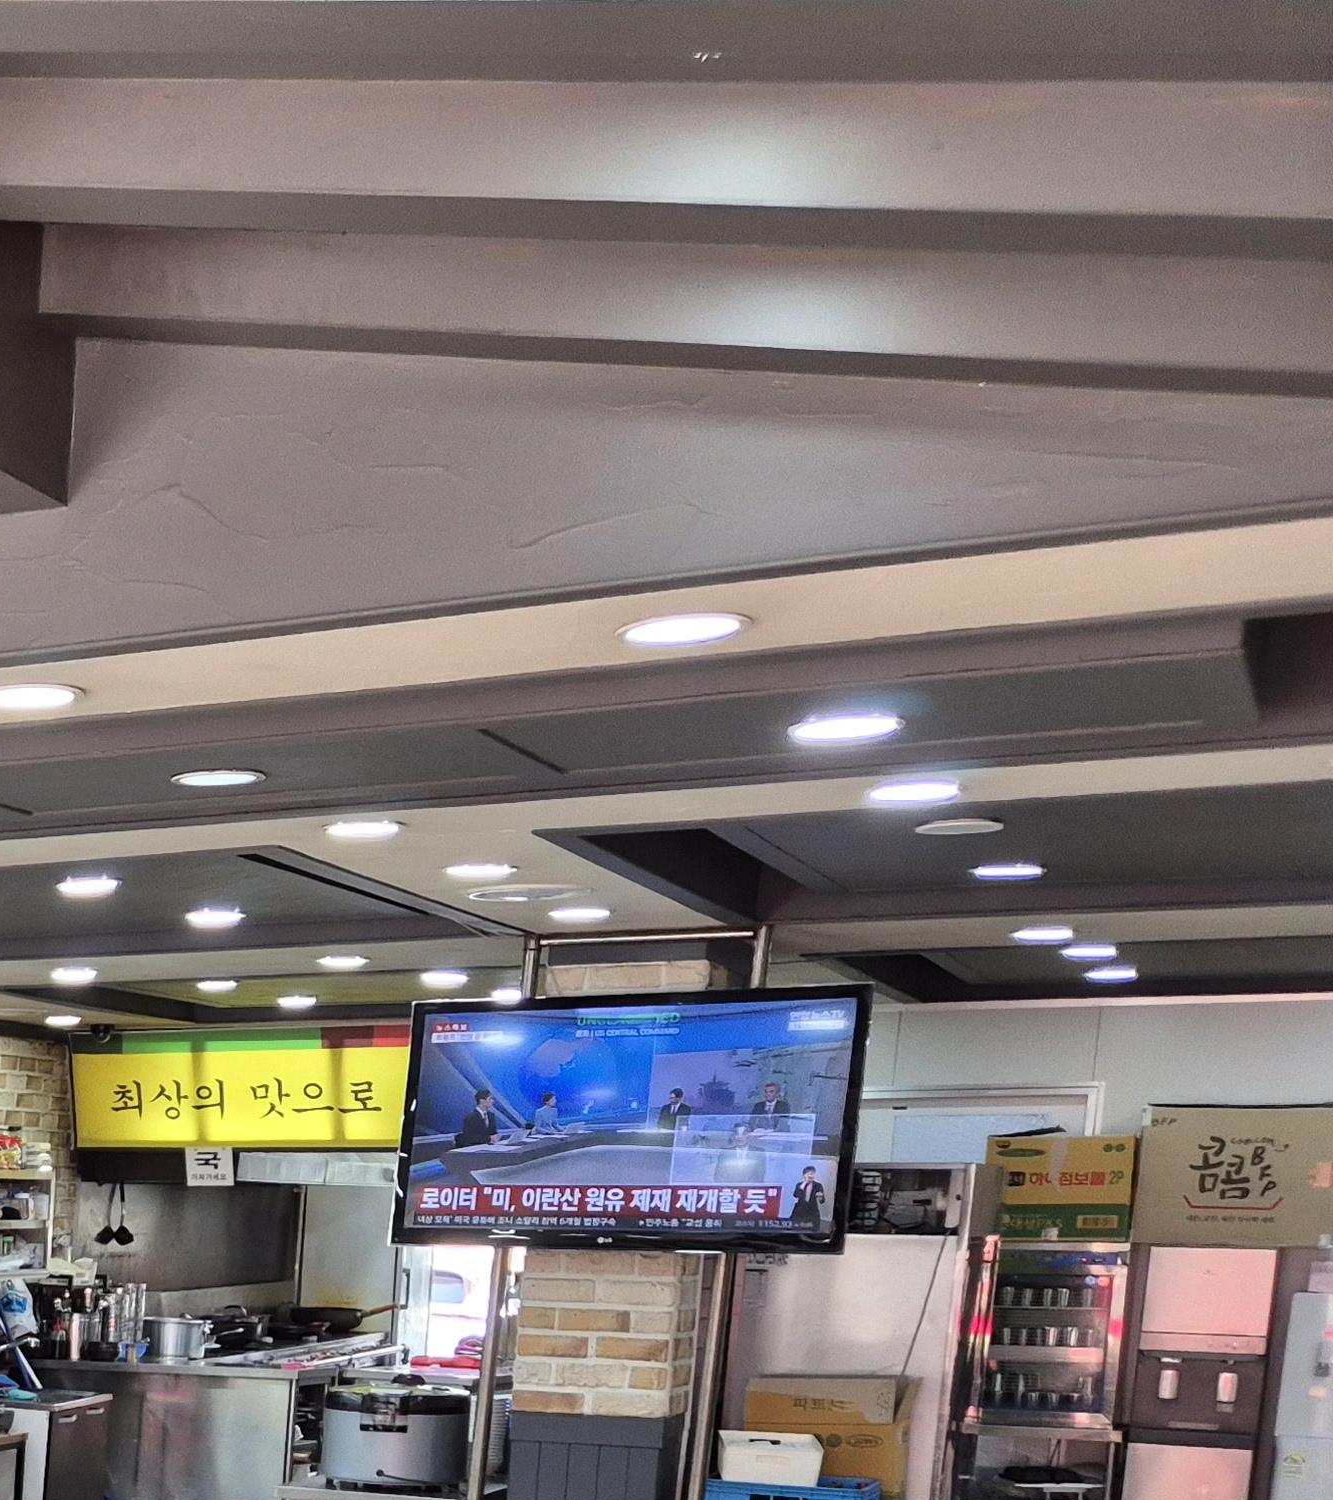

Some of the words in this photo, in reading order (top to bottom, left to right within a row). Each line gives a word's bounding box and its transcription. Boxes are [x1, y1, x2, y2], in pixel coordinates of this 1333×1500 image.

[111, 1078, 225, 1120] 최상의
[250, 1077, 383, 1120] 맛으로
[194, 1151, 221, 1170] 국
[420, 1187, 477, 1211] 로이터
[522, 1187, 582, 1212] 이란산
[585, 1187, 625, 1212] 원유
[629, 1188, 672, 1213] 제재
[676, 1188, 741, 1214] 재개할
